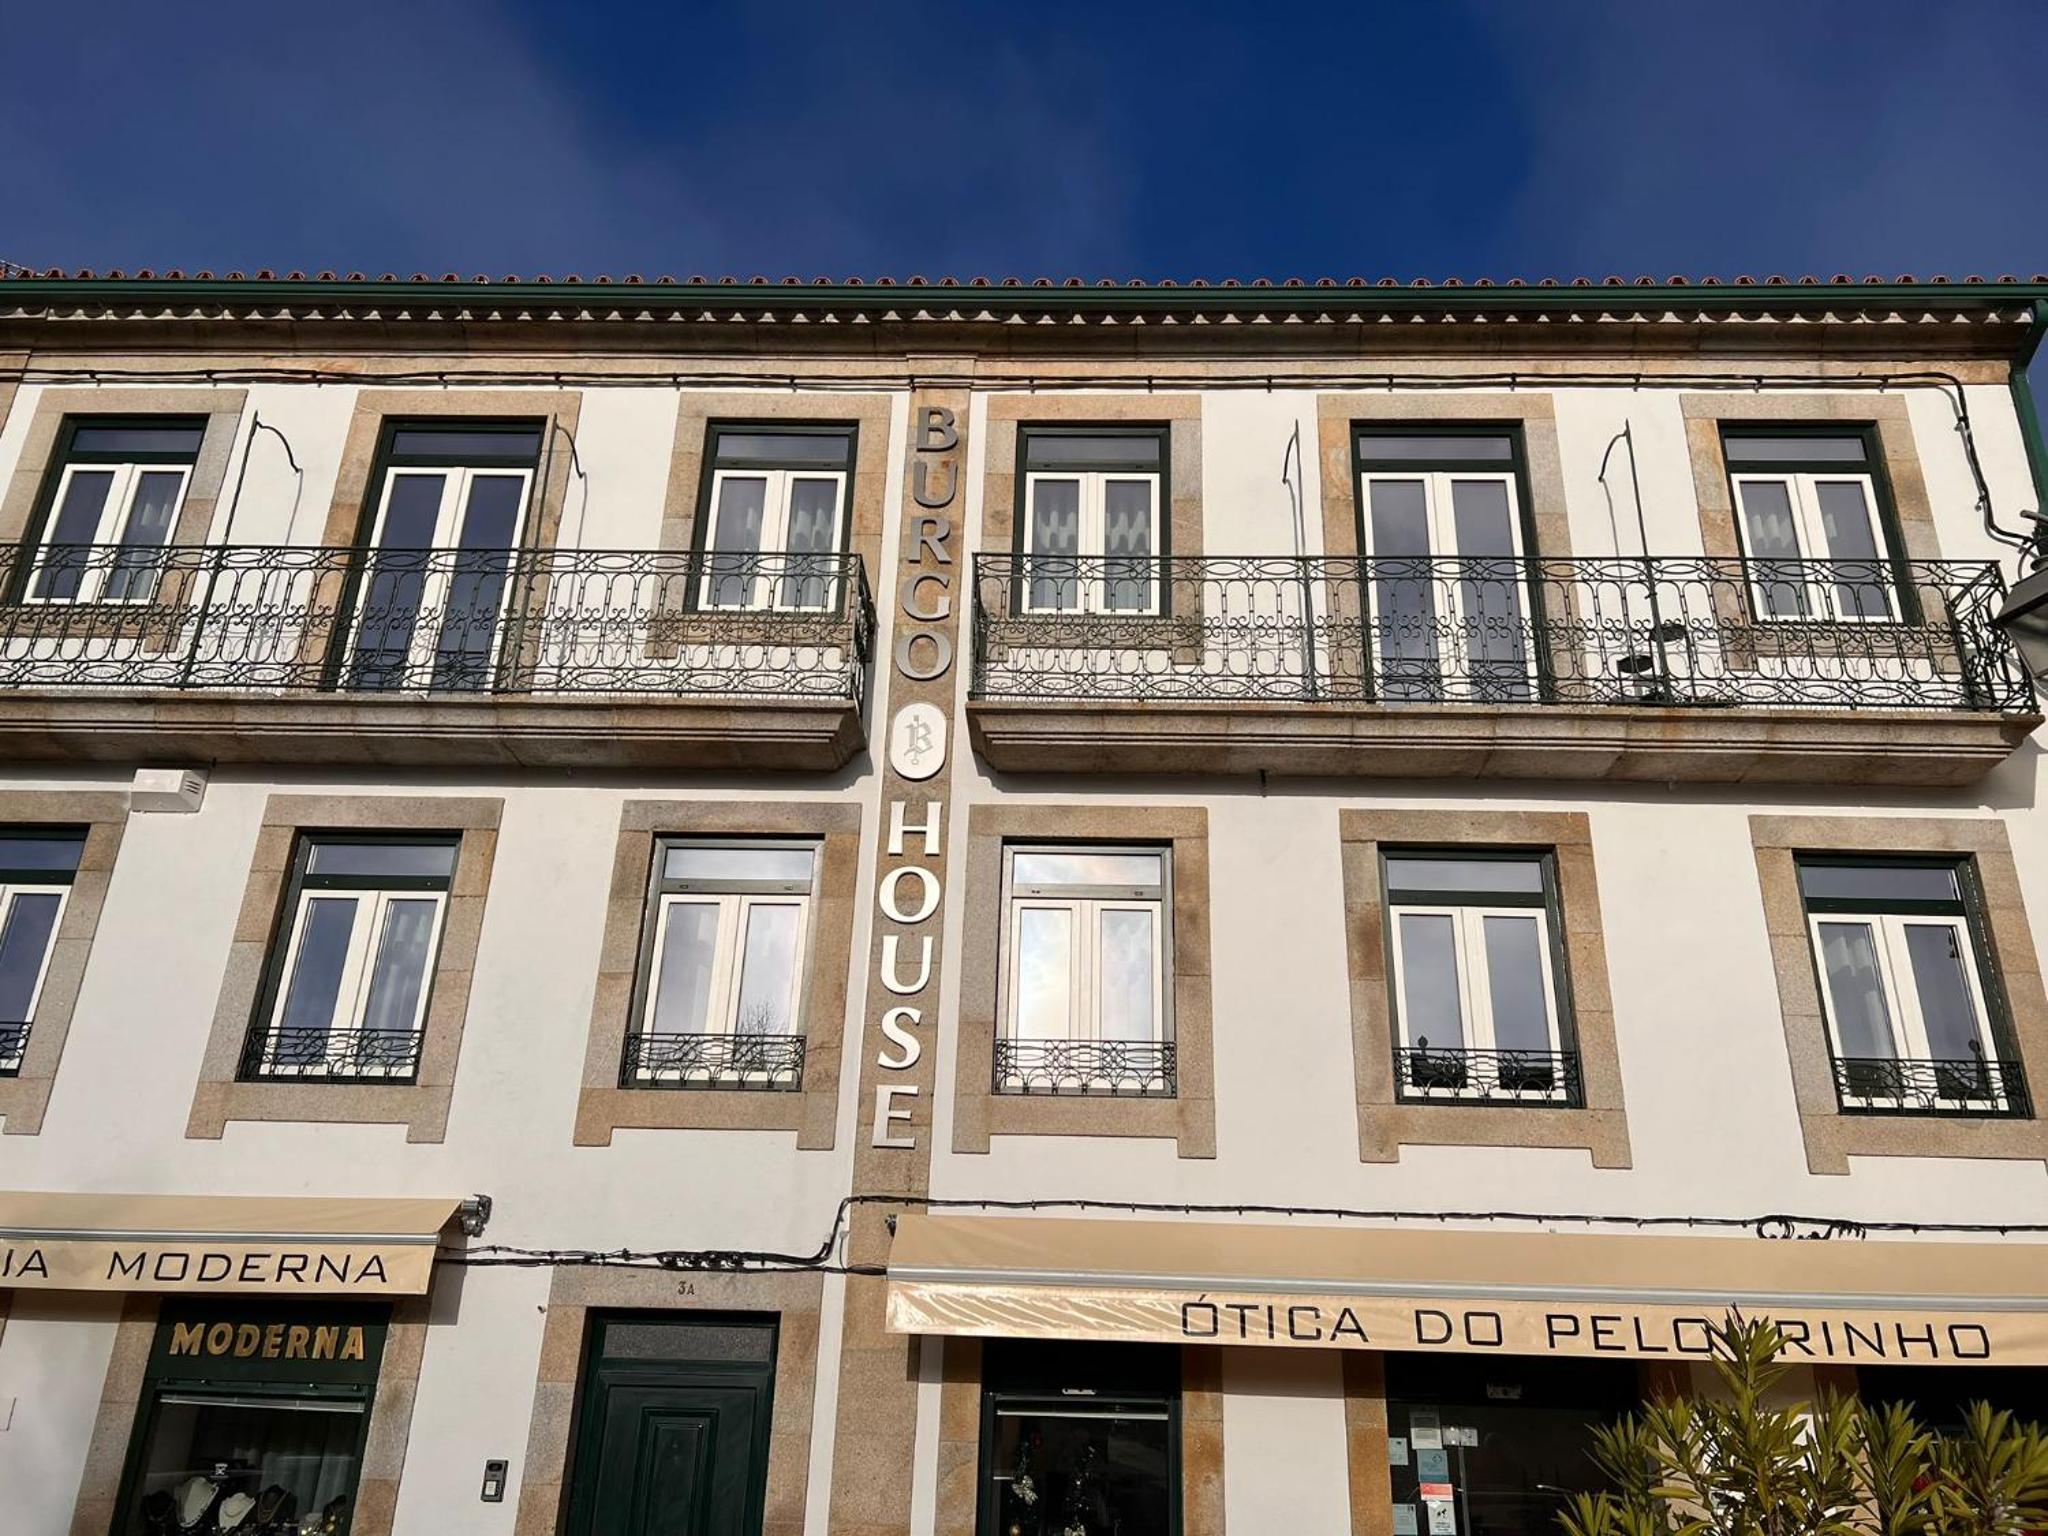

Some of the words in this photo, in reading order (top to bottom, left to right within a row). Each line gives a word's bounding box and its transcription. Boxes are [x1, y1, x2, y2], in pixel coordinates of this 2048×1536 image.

[895, 406, 959, 681] BURGO
[871, 800, 943, 1149] HOUSE
[106, 1250, 389, 1284] MODERNA
[678, 1280, 695, 1295] 3A
[168, 1322, 365, 1361] MODERNA
[1181, 1294, 1369, 1343] ÓTICA
[1415, 1309, 1503, 1347] DO
[1545, 1313, 1991, 1359] PELORINHO
